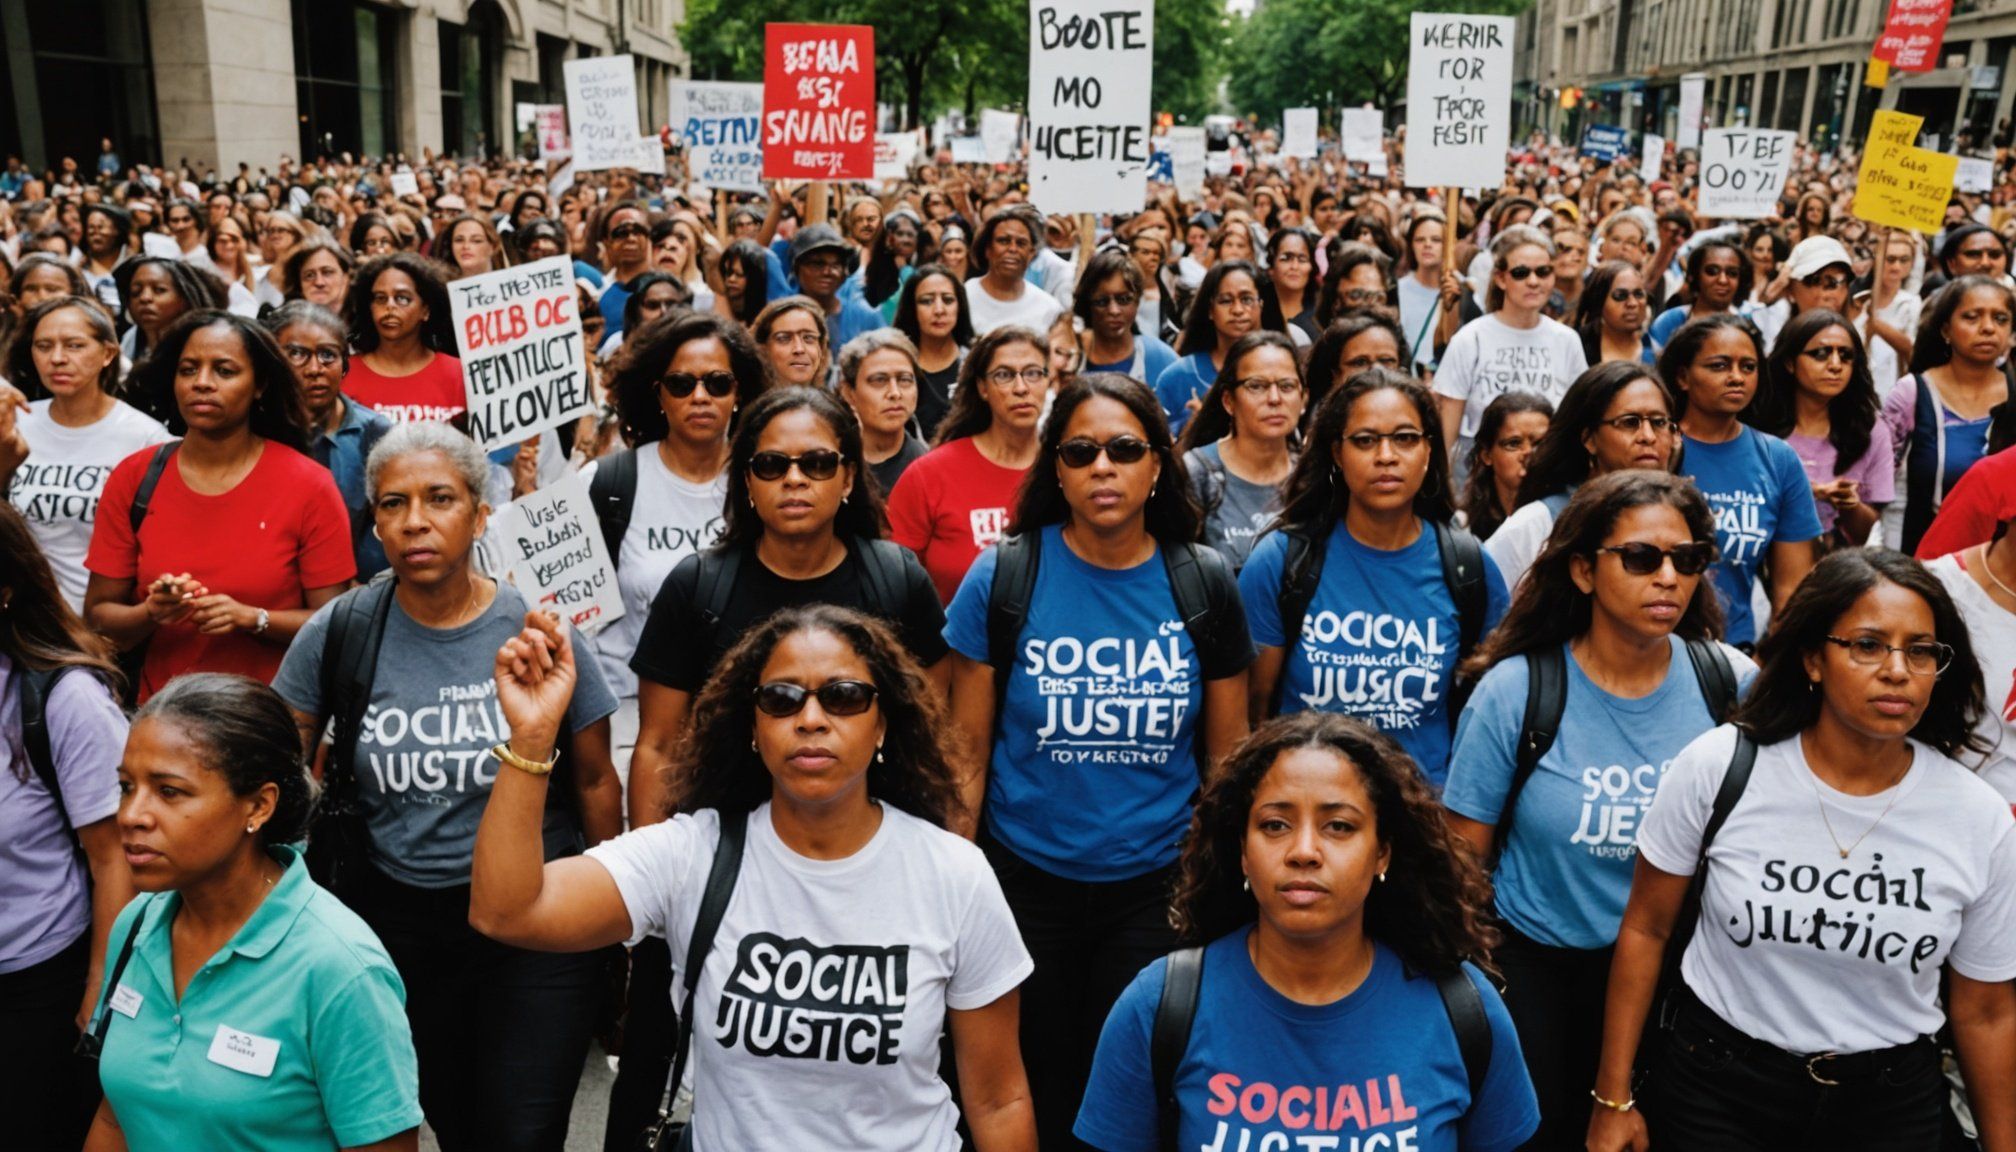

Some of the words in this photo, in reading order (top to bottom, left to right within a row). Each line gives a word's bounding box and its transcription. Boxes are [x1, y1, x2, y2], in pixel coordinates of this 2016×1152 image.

[1053, 76, 1101, 109] MO
[736, 942, 907, 1007] SOCIAL
[1207, 1072, 1418, 1131] SOCIALL
